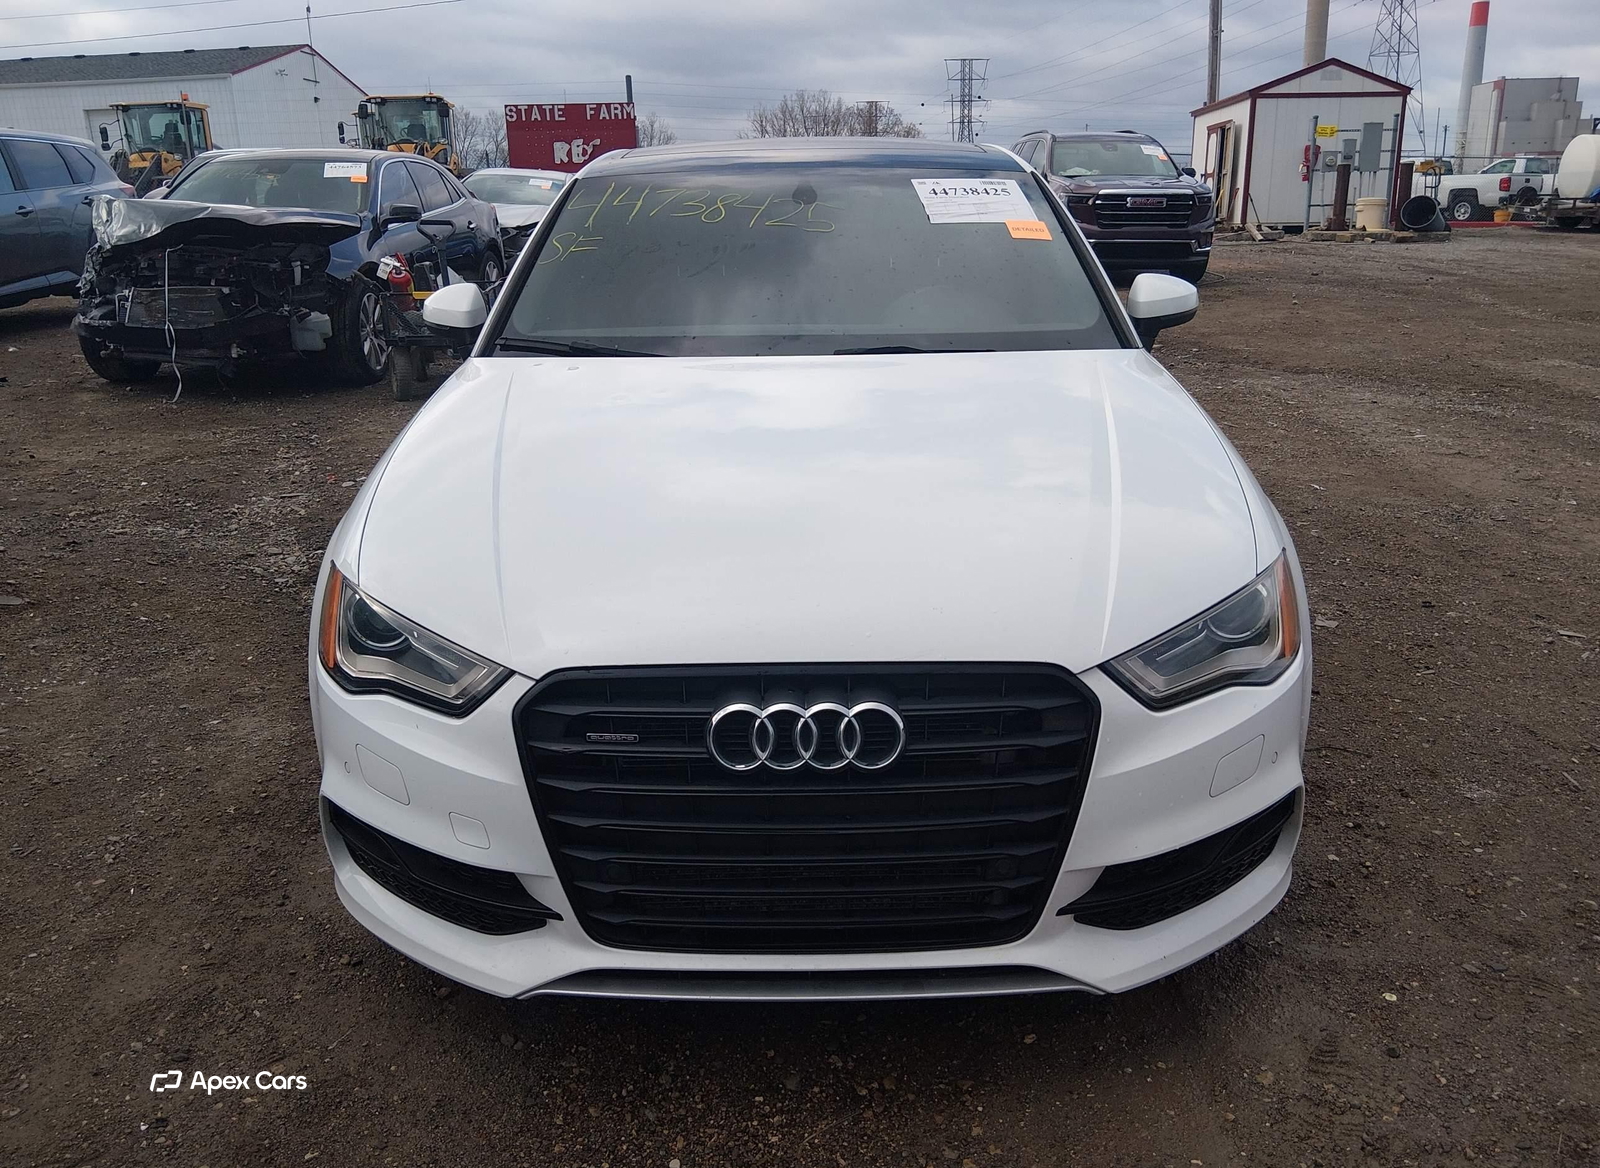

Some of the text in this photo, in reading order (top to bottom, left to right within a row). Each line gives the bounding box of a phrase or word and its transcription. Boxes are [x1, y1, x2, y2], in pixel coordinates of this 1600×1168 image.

[505, 103, 635, 121] STATE FARM
[928, 187, 1012, 197] 44738425
[567, 181, 846, 233] 44738425
[538, 231, 604, 265] SF
